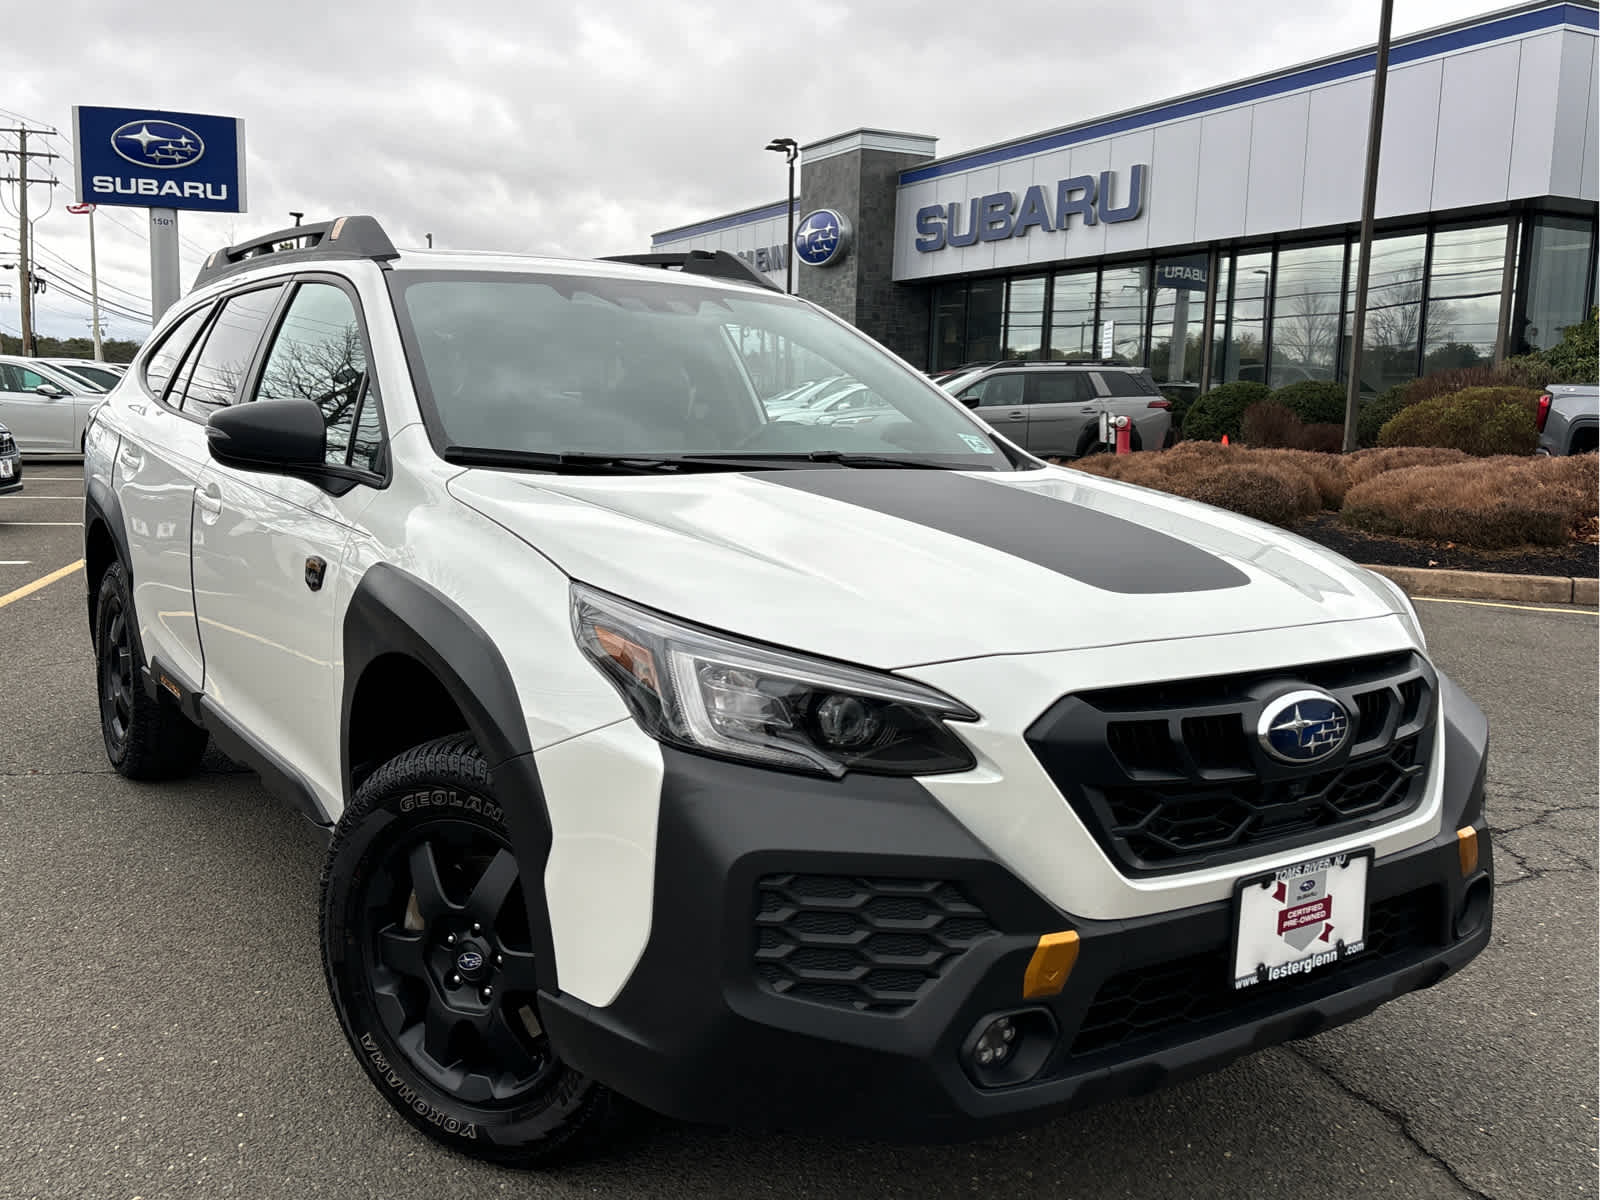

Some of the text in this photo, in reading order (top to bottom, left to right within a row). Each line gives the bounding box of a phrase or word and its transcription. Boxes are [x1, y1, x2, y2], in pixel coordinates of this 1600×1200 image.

[92, 175, 228, 201] SUBARU
[152, 217, 174, 227] 1501
[914, 164, 1148, 254] SUBARU
[399, 789, 506, 825] GEOLAN
[1275, 865, 1303, 881] TOMS
[1334, 854, 1347, 866] NJ
[1282, 910, 1327, 928] PRE-OWNED
[1287, 902, 1324, 919] CERTIFIED
[360, 1032, 477, 1139] YOKOHAMA
